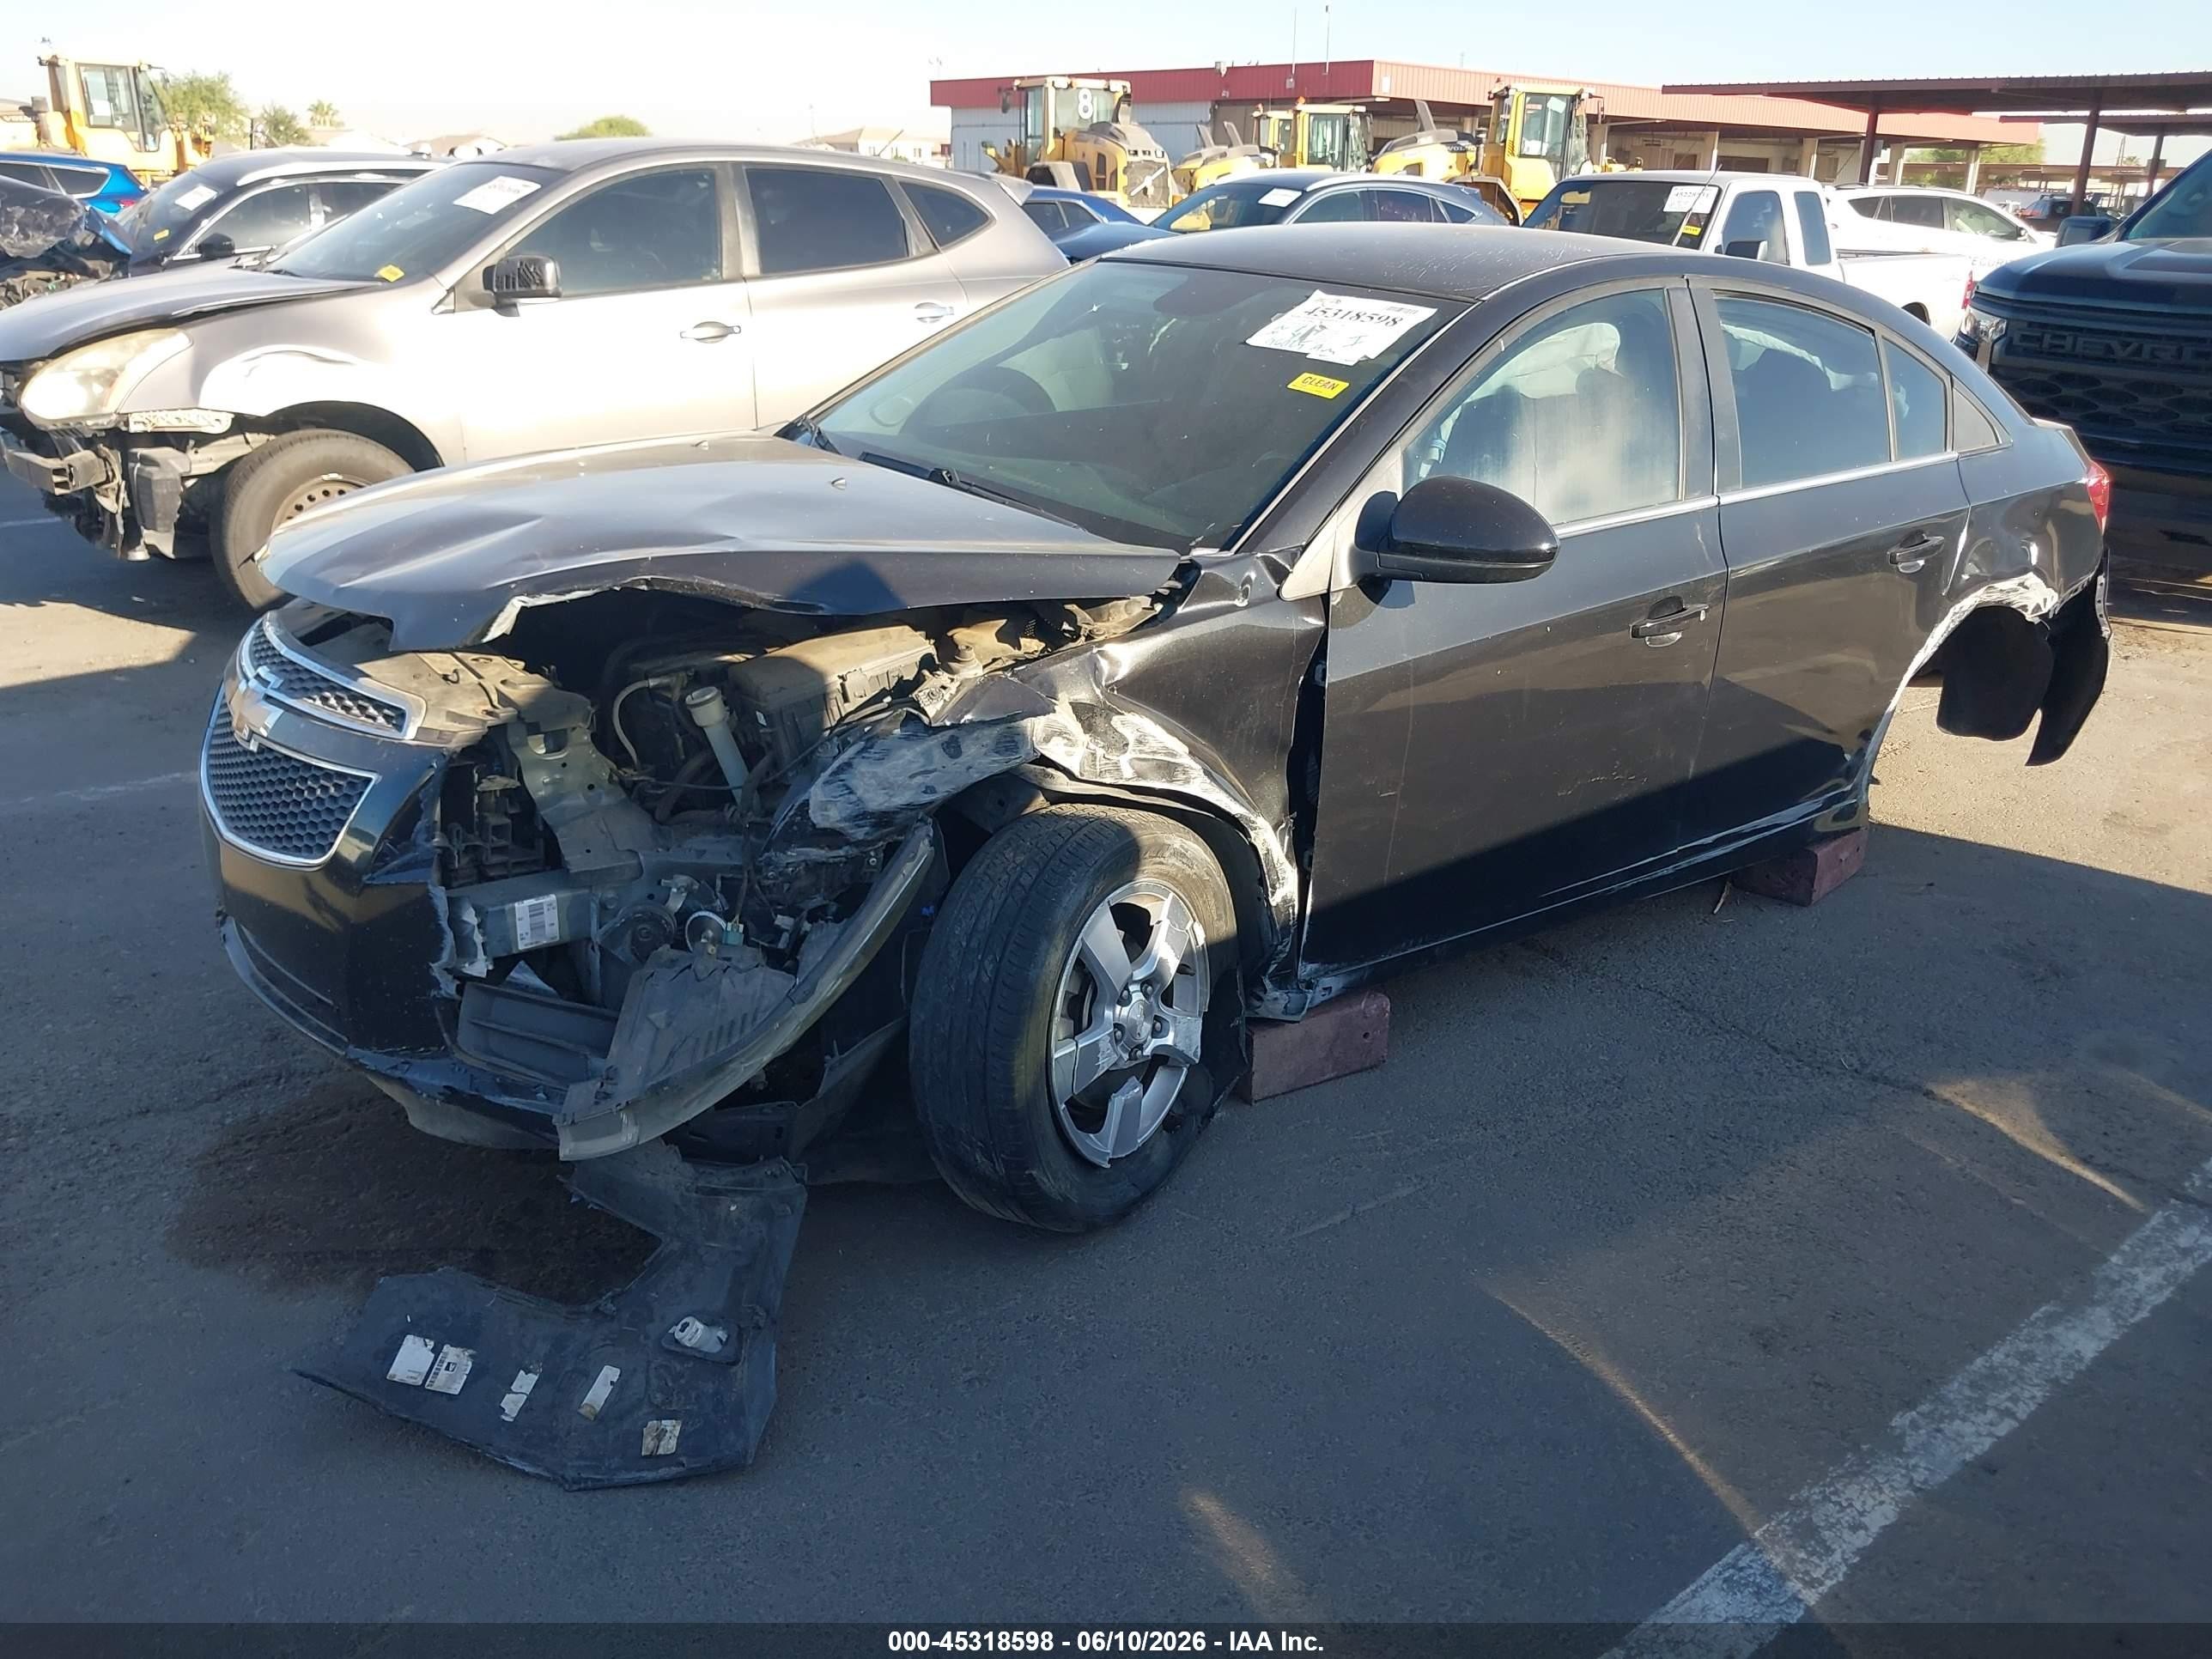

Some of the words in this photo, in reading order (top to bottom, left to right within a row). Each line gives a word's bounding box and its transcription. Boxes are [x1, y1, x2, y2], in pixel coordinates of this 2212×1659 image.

[1079, 88, 1093, 119] 8
[1304, 307, 1403, 327] 45318598
[1301, 376, 1340, 391] CLEAN
